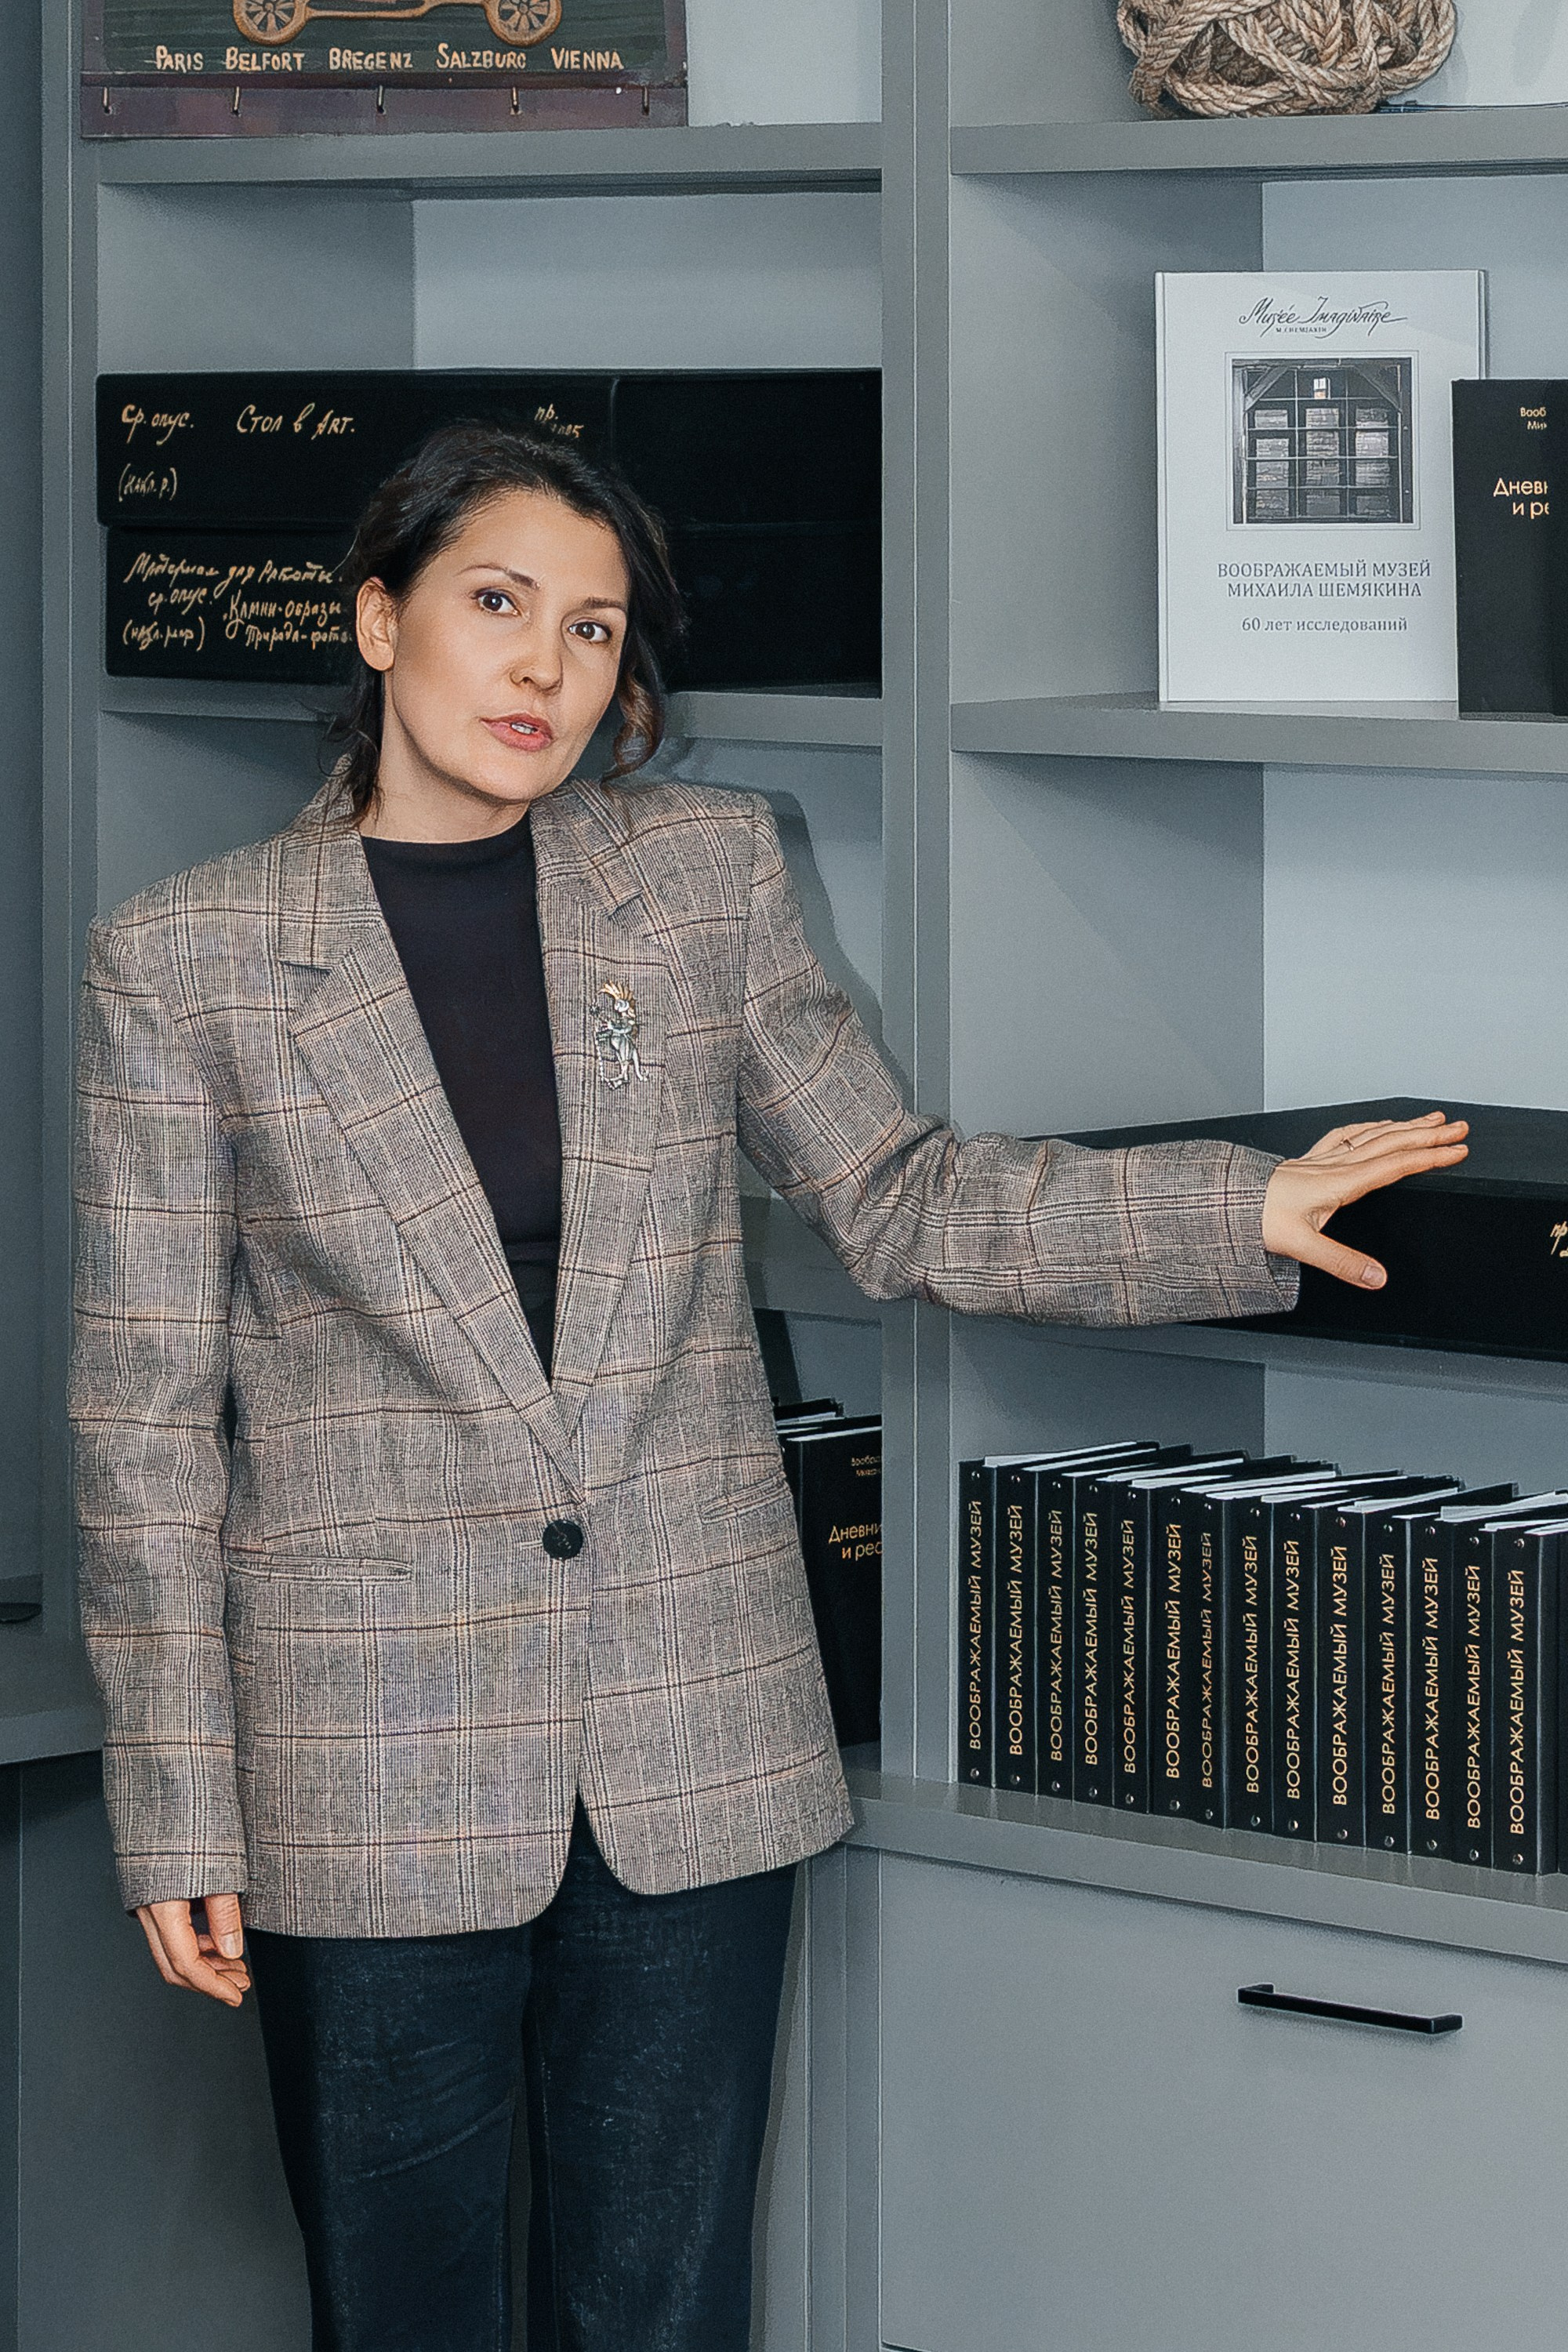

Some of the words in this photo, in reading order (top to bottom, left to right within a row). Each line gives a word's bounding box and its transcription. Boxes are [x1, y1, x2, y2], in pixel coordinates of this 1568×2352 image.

[156, 45, 204, 73] PARIS
[226, 46, 305, 71] BELFORT
[550, 47, 625, 70] VIENNA
[1512, 501, 1525, 516] и
[1218, 560, 1367, 578] ВООБРАЖАЕМЫЙ
[1372, 559, 1432, 578] МУЗЕЙ
[1227, 583, 1314, 597] МИХАИЛА
[1318, 583, 1422, 597] ШЕМЯКИНА
[1241, 617, 1261, 631] 60
[1264, 619, 1293, 631] лет
[1296, 616, 1408, 633] исследований
[969, 1501, 982, 1569] МУЗЕЙ
[1007, 1504, 1023, 1573] МУЗЕЙ
[1048, 1511, 1062, 1579] МУЗЕЙ
[1083, 1513, 1098, 1581] МУЗЕЙ
[1122, 1519, 1134, 1588] МУЗЕЙ
[1166, 1523, 1182, 1593] МУЗЕЙ
[1201, 1534, 1212, 1602] МУЗЕЙ
[1243, 1535, 1258, 1606] МУЗЕЙ
[1283, 1540, 1300, 1610] МУЗЕЙ
[1330, 1545, 1348, 1617] МУЗЕЙ
[1379, 1555, 1396, 1624] МУЗЕЙ
[1422, 1557, 1439, 1629] МУЗЕЙ
[1465, 1566, 1481, 1637] МУЗЕЙ
[1508, 1570, 1525, 1642] МУЗЕЙ
[968, 1575, 982, 1748] ВООБРАЖАЕМЫЙ
[1007, 1580, 1023, 1755] ВООБРАЖАЕМЫЙ
[1048, 1584, 1063, 1761] ВООБРАЖАЕМЫЙ
[1083, 1588, 1098, 1765] ВООБРАЖАЕМЫЙ
[1121, 1595, 1136, 1773] ВООБРАЖАЕМЫЙ
[1164, 1600, 1181, 1779] ВООБРАЖАЕМЫЙ
[1201, 1609, 1213, 1788] ВООБРАЖАЕМЫЙ
[1243, 1613, 1260, 1793] ВООБРАЖАЕМЫЙ
[1283, 1617, 1301, 1799] ВООБРАЖАЕМЫЙ
[1330, 1623, 1348, 1806] ВООБРАЖАЕМЫЙ
[1379, 1632, 1396, 1813] ВООБРАЖАЕМЫЙ
[1422, 1636, 1440, 1820] ВООБРАЖАЕМЫЙ
[1465, 1643, 1481, 1828] ВООБРАЖАЕМЫЙ
[1506, 1649, 1525, 1835] ВООБРАЖАЕМЫЙ
